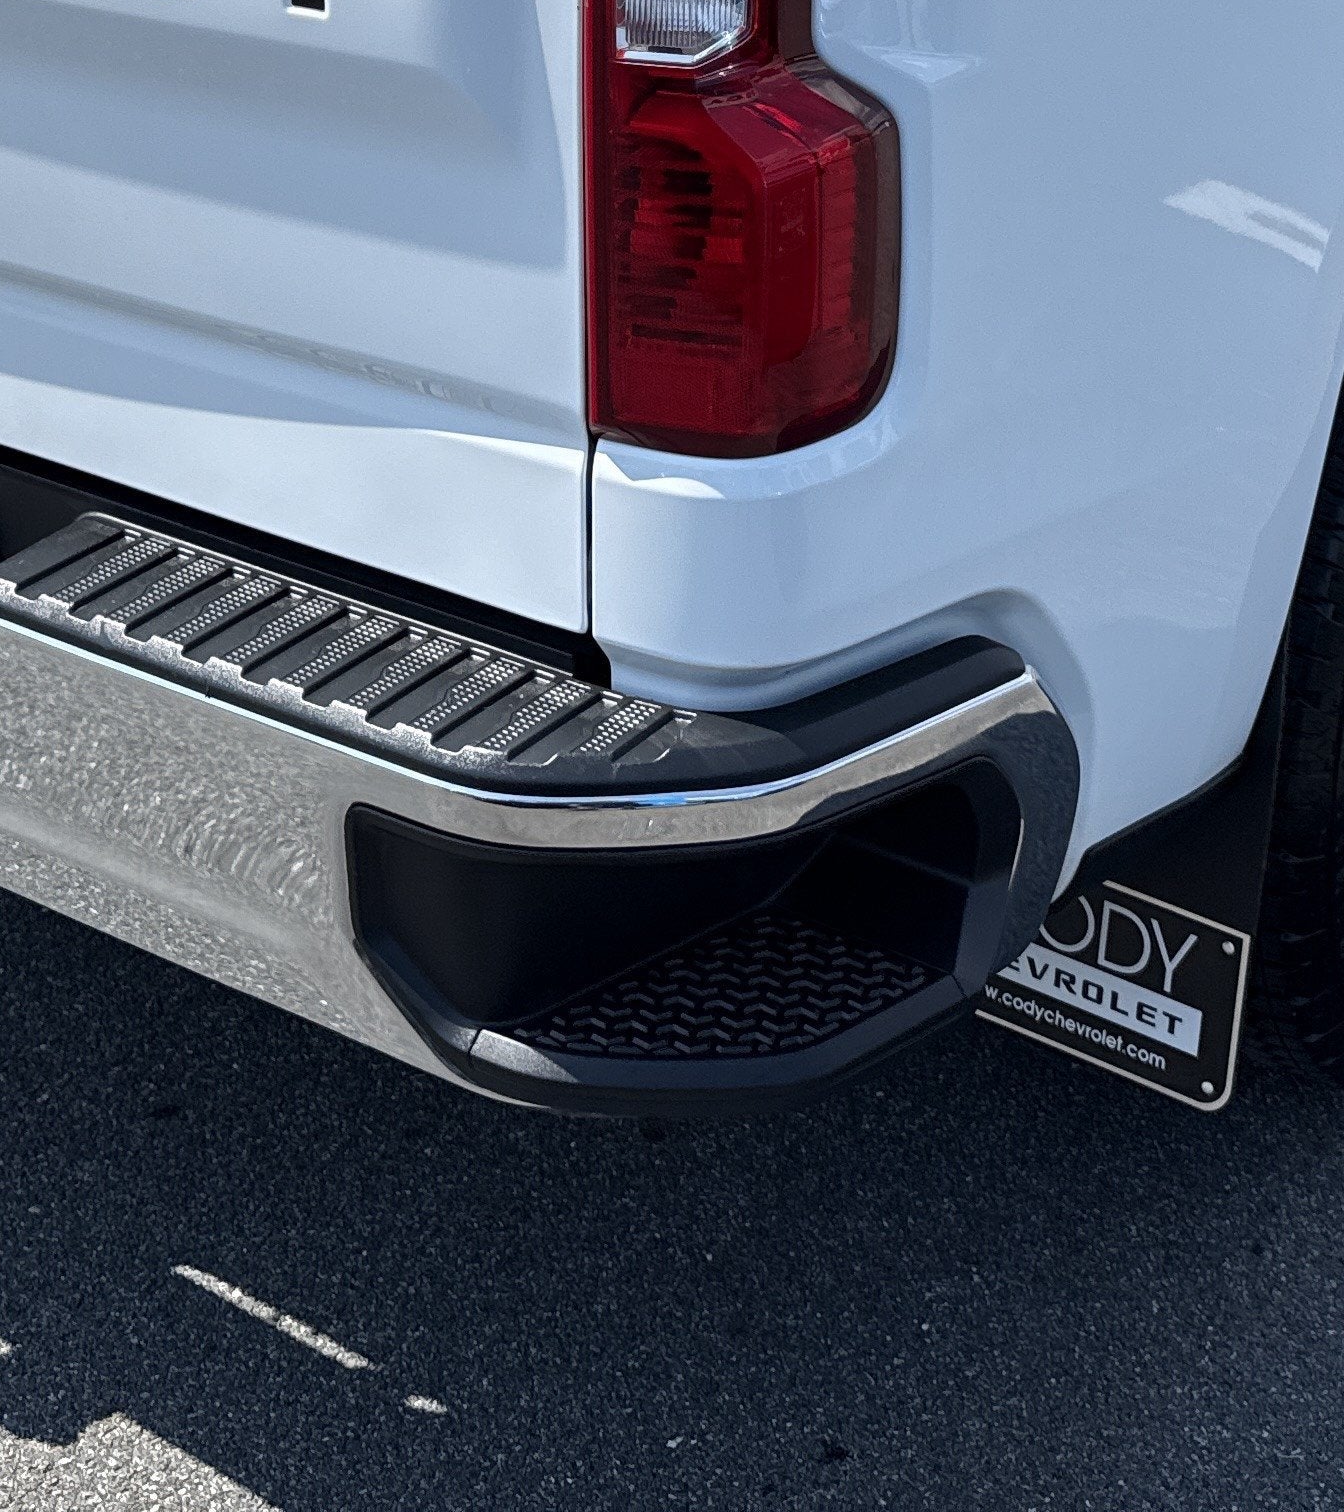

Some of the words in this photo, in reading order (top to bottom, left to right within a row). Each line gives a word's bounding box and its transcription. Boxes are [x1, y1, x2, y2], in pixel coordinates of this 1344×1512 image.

[1039, 895, 1198, 993] ODY
[984, 984, 1167, 1071] w.codychevrolet.com
[1008, 954, 1183, 1036] VROLET
